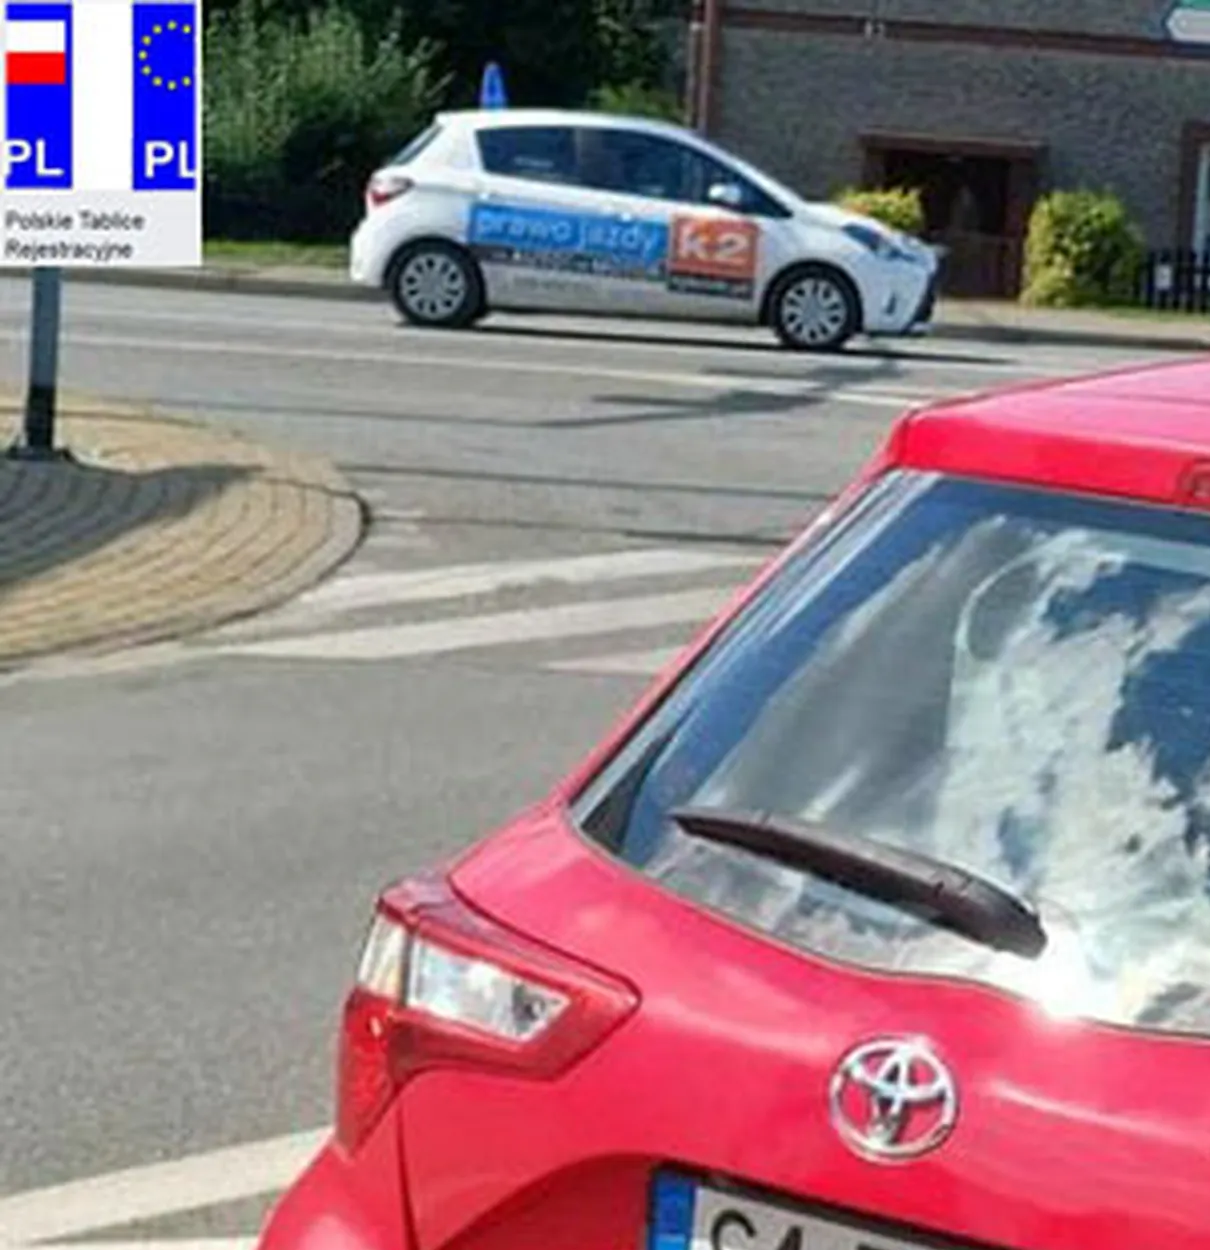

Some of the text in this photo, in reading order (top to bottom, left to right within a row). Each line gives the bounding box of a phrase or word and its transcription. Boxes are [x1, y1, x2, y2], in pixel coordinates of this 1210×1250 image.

[475, 210, 660, 257] prawo jazdy
[679, 219, 750, 262] k2
